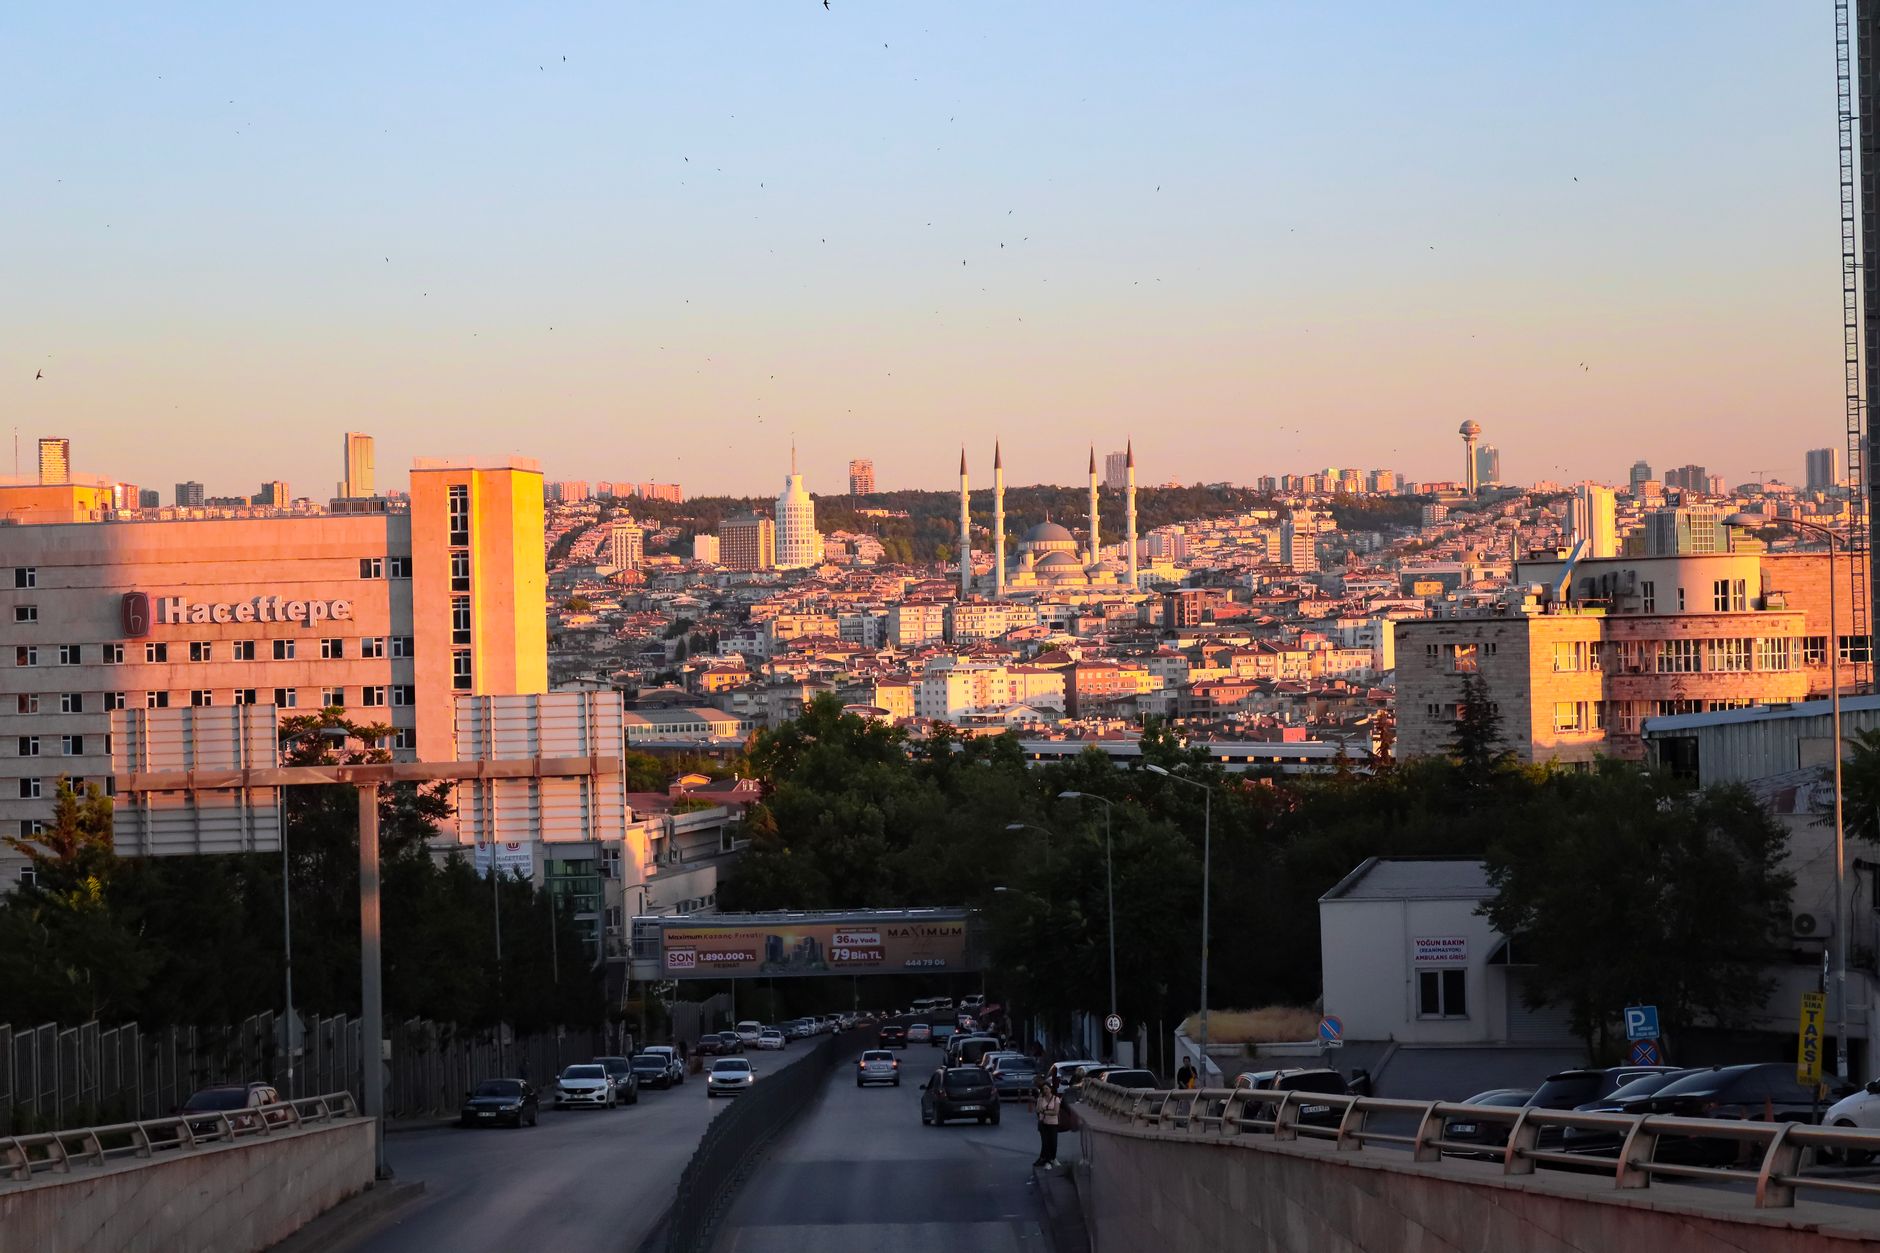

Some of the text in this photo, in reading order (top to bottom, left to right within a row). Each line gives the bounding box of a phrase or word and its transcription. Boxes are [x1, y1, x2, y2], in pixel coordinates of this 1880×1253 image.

[164, 595, 351, 628] Hacettepe
[888, 926, 962, 937] MAXIMUM
[669, 953, 694, 963] SON
[699, 952, 744, 961] 1.890.000
[832, 948, 882, 960] 79 Bin TL
[1627, 1010, 1646, 1036] P
